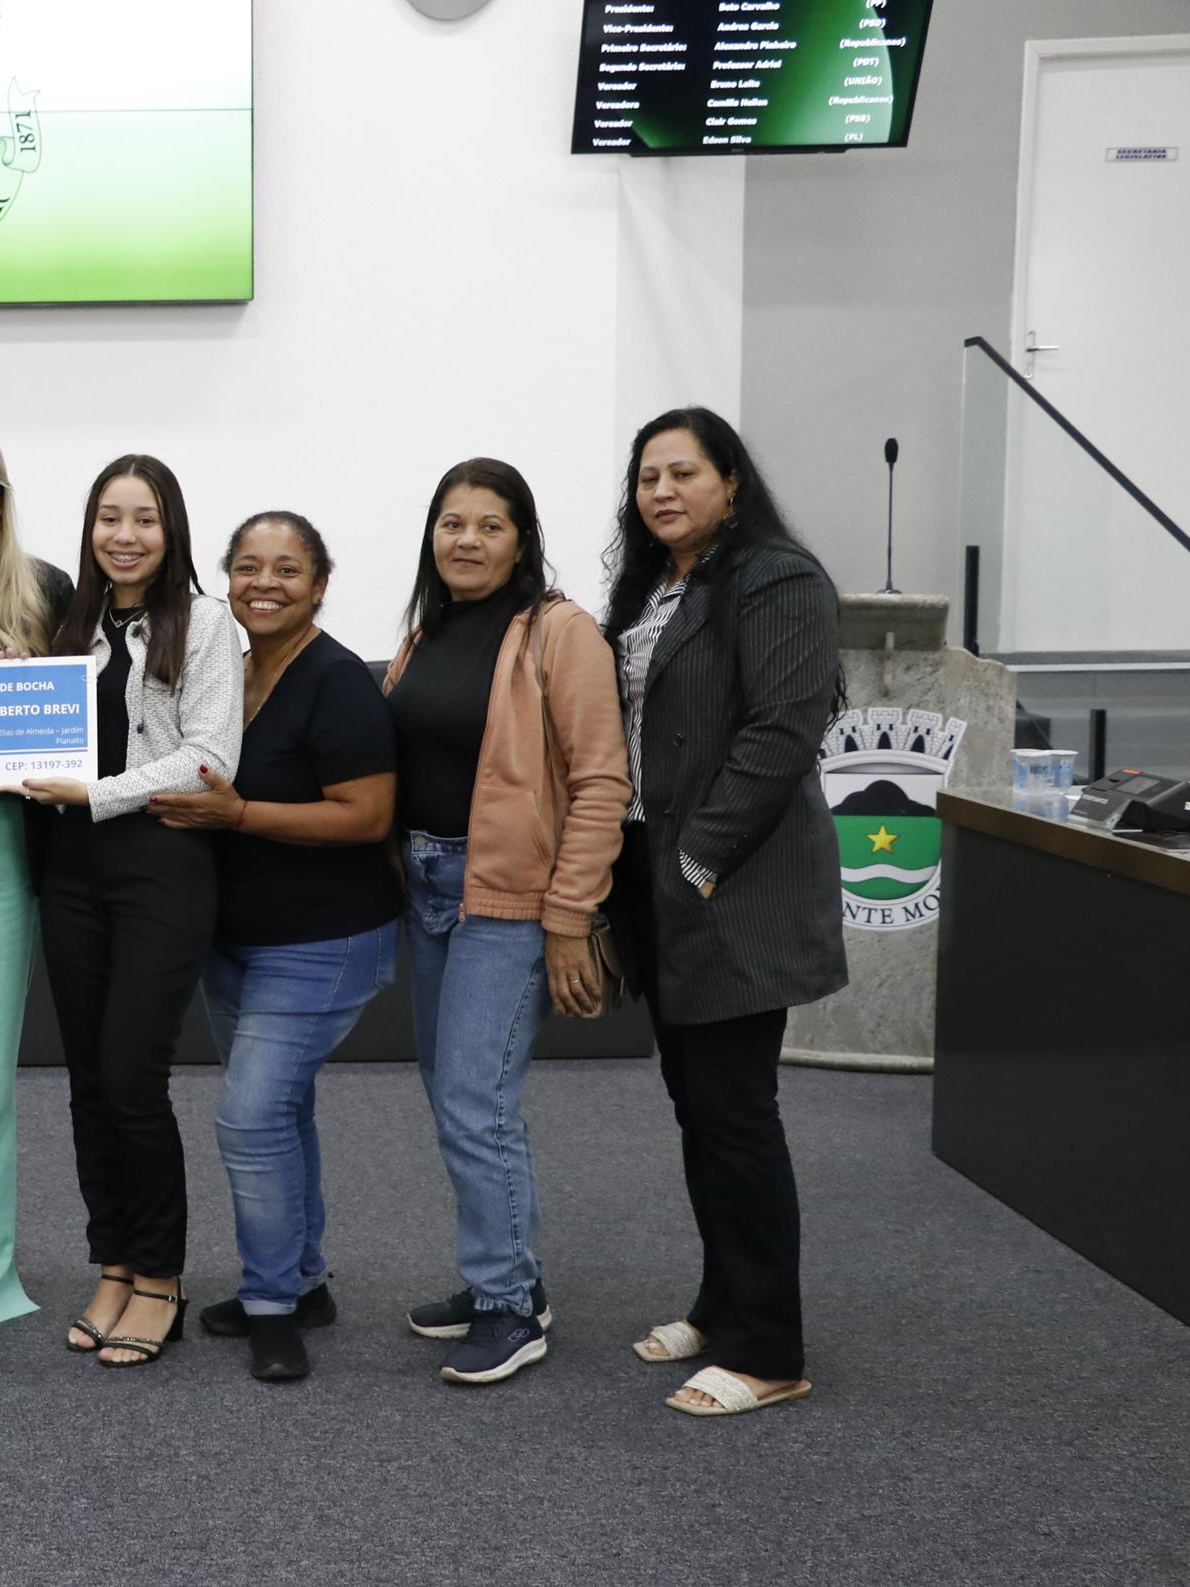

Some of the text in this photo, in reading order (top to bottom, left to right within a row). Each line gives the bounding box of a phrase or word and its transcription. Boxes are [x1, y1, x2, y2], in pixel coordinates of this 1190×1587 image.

[605, 4, 655, 14] Presidente:
[741, 1, 780, 11] Carvalho
[601, 43, 638, 53] Primeiro
[760, 40, 797, 50] Pinheiro
[839, 37, 906, 49] (Republicanos)
[599, 63, 637, 73] Segundo
[712, 60, 754, 70] Professor
[853, 57, 879, 68] (PDT)
[597, 81, 637, 91] Vereador
[710, 79, 737, 89] Bruno
[844, 75, 882, 87] (UNIÃO)
[595, 100, 640, 110] Vereadora
[828, 95, 894, 106] (Republicanos)
[594, 119, 633, 128] Vereador
[727, 116, 757, 126] Gomes
[14, 109, 36, 152] 1871
[592, 137, 631, 147] Vereador
[703, 135, 728, 145] Edson
[730, 134, 751, 144] Silva
[0, 682, 13, 692] DE
[16, 681, 55, 692] BOCHA
[44, 703, 80, 715] BREVI
[15, 727, 25, 736] de
[26, 726, 54, 736] Almeida
[61, 726, 84, 736] Jardim
[55, 737, 84, 745] Planalto
[5, 759, 83, 771] CEP: 13197-392
[842, 890, 941, 924] NTE MO
